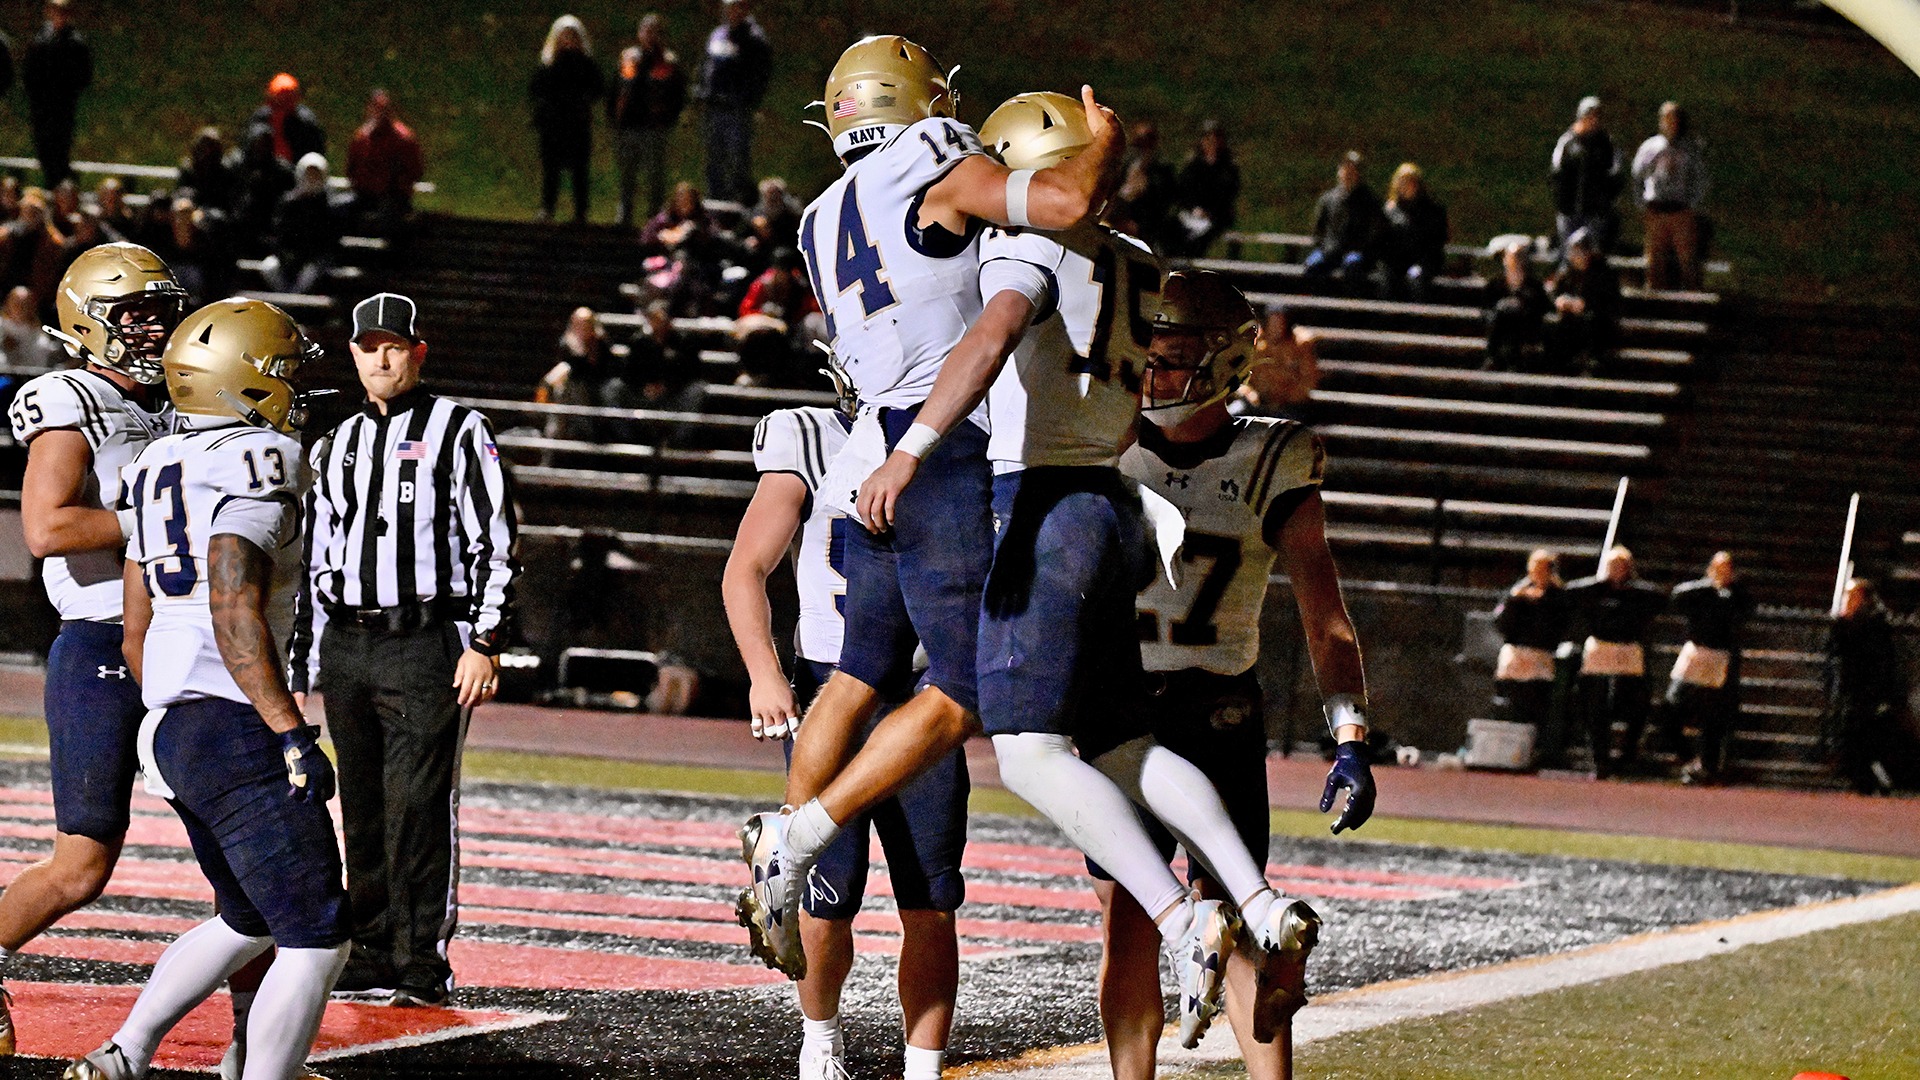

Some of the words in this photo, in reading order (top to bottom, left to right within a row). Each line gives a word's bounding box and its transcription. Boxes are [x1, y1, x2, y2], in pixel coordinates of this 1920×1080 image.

[848, 126, 886, 145] NAVY
[919, 121, 970, 168] 14
[800, 172, 902, 346] 14
[12, 388, 44, 432] 55
[243, 446, 288, 492] 13
[343, 451, 355, 467] S
[400, 481, 415, 503] B
[132, 460, 202, 600] 13
